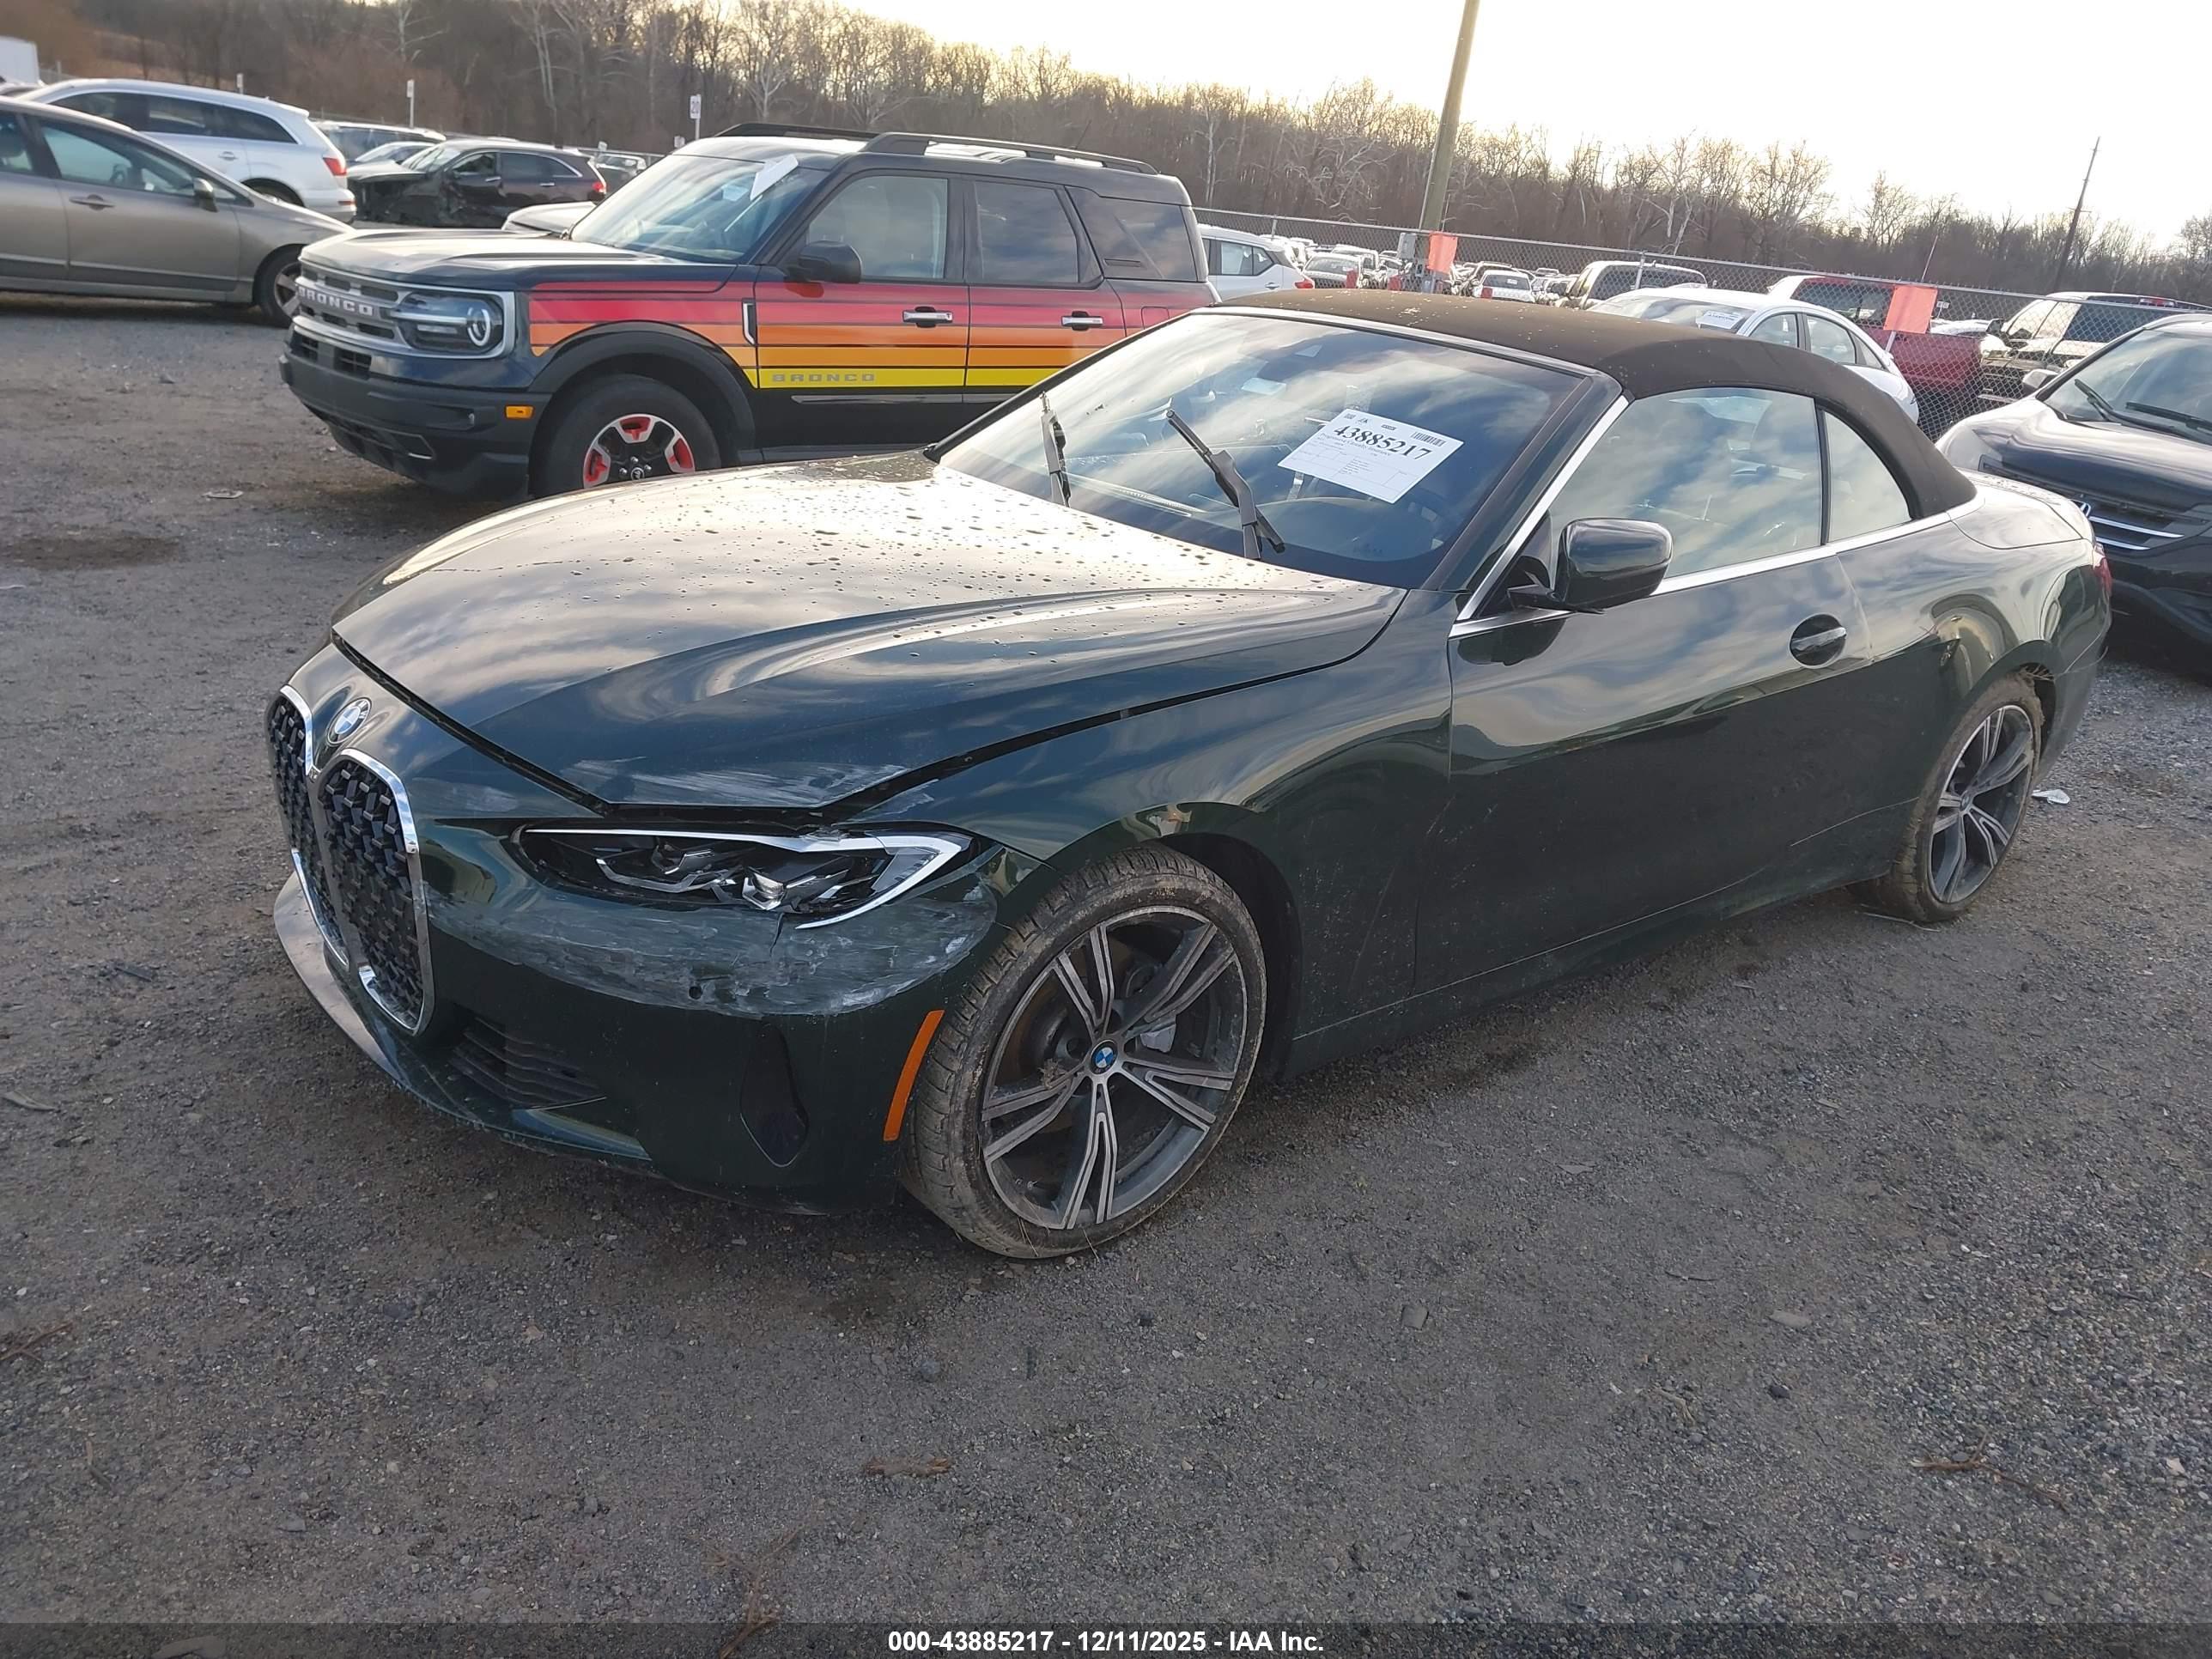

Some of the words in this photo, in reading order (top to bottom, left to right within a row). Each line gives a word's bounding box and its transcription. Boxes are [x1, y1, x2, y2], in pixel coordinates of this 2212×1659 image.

[297, 285, 373, 316] BRONCO
[772, 374, 875, 382] BRONCO
[1333, 425, 1433, 460] 43885217
